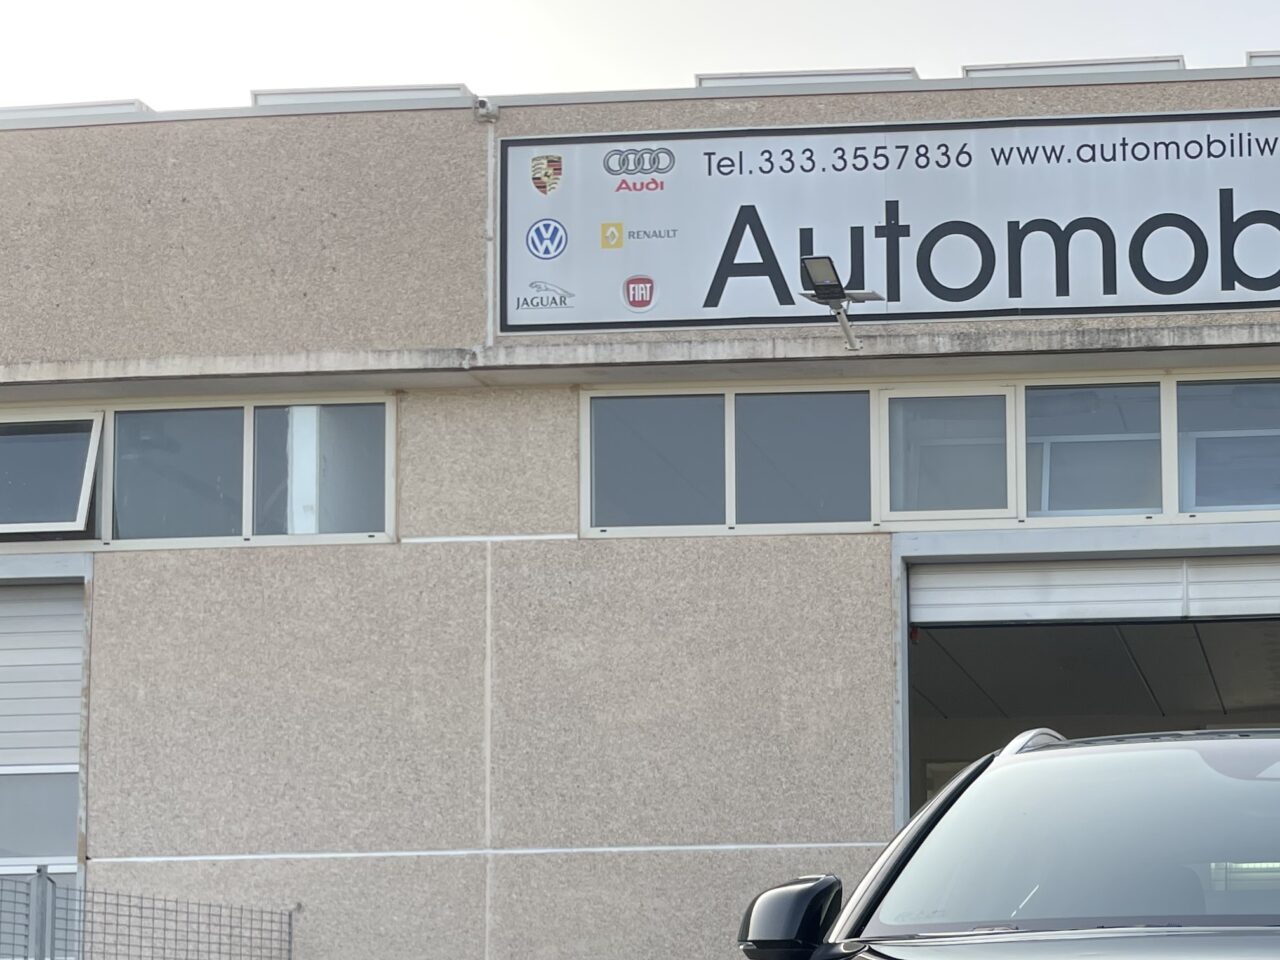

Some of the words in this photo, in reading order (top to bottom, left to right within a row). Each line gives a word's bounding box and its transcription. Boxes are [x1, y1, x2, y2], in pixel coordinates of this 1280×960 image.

[703, 143, 972, 176] Tel.333.3557836
[615, 178, 664, 192] Audi
[628, 229, 679, 240] RENAULT
[629, 284, 652, 301] FIAT
[516, 296, 567, 310] JAGUAR
